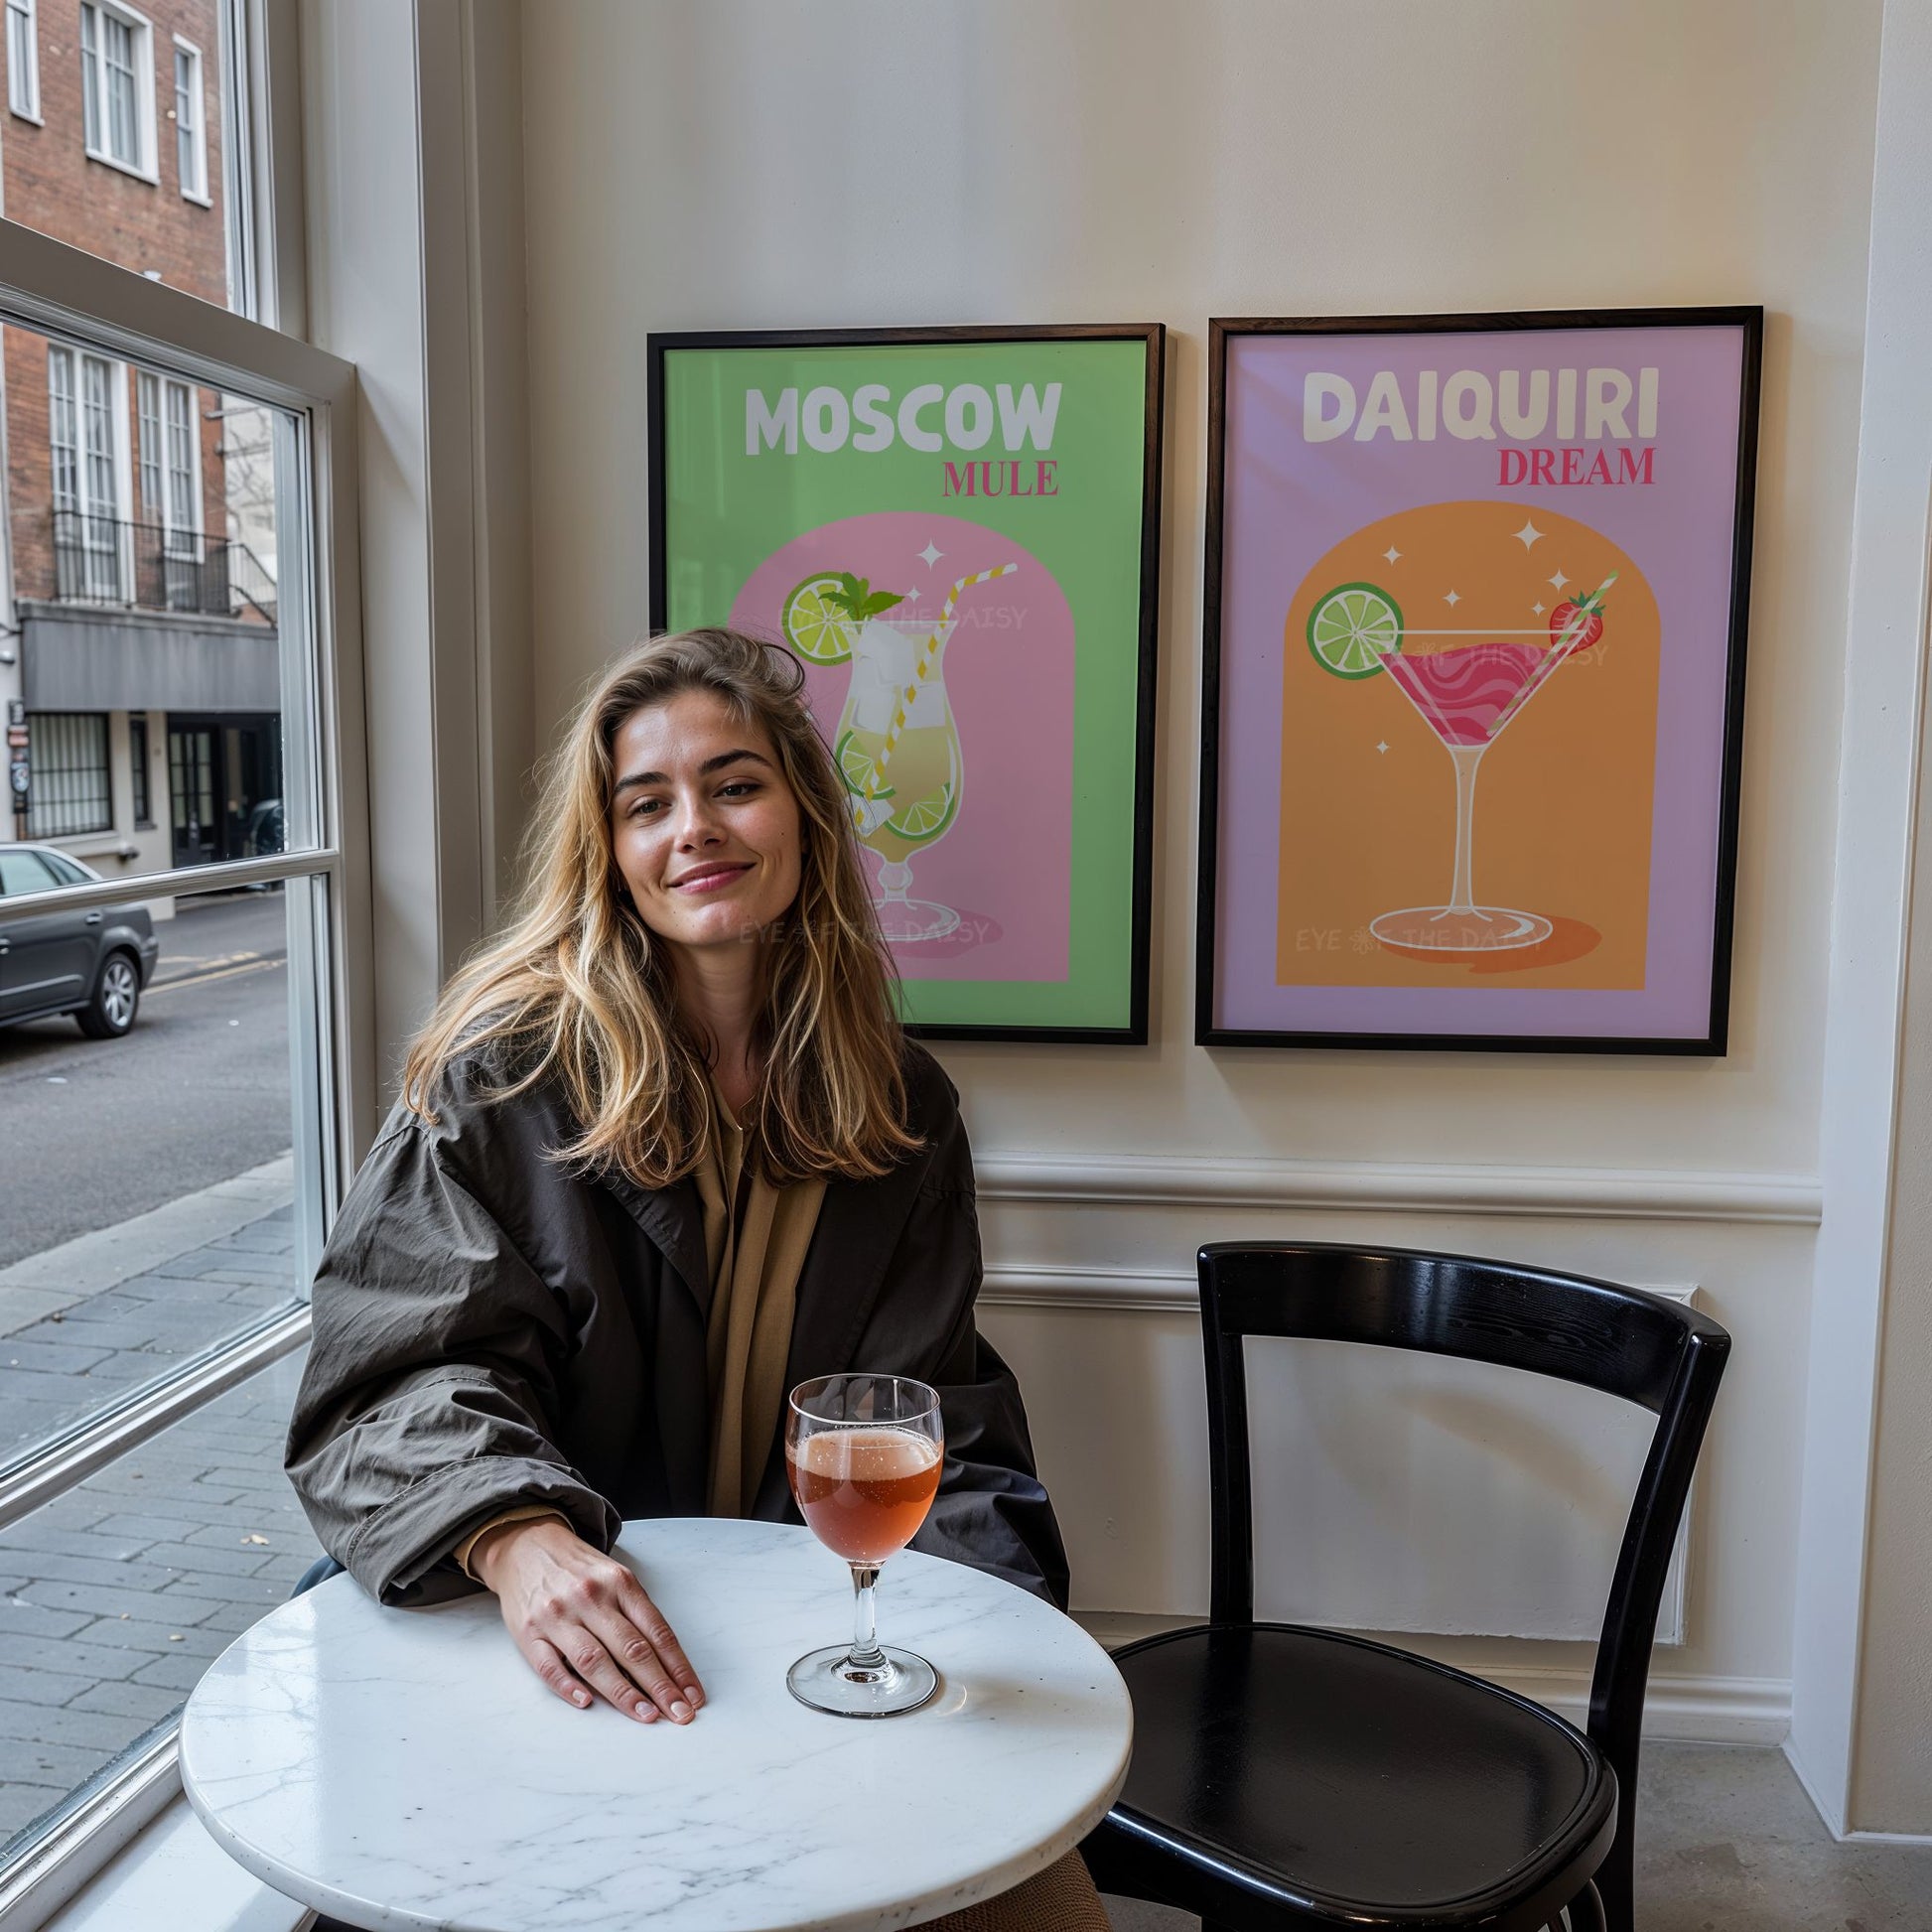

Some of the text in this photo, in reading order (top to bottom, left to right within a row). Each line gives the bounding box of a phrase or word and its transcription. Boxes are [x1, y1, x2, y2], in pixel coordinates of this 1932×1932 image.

[746, 382, 1063, 456] MOSCOW
[1303, 367, 1659, 443] DAIQUIRI
[942, 460, 1059, 497] MULE
[1495, 447, 1657, 486] DREAM
